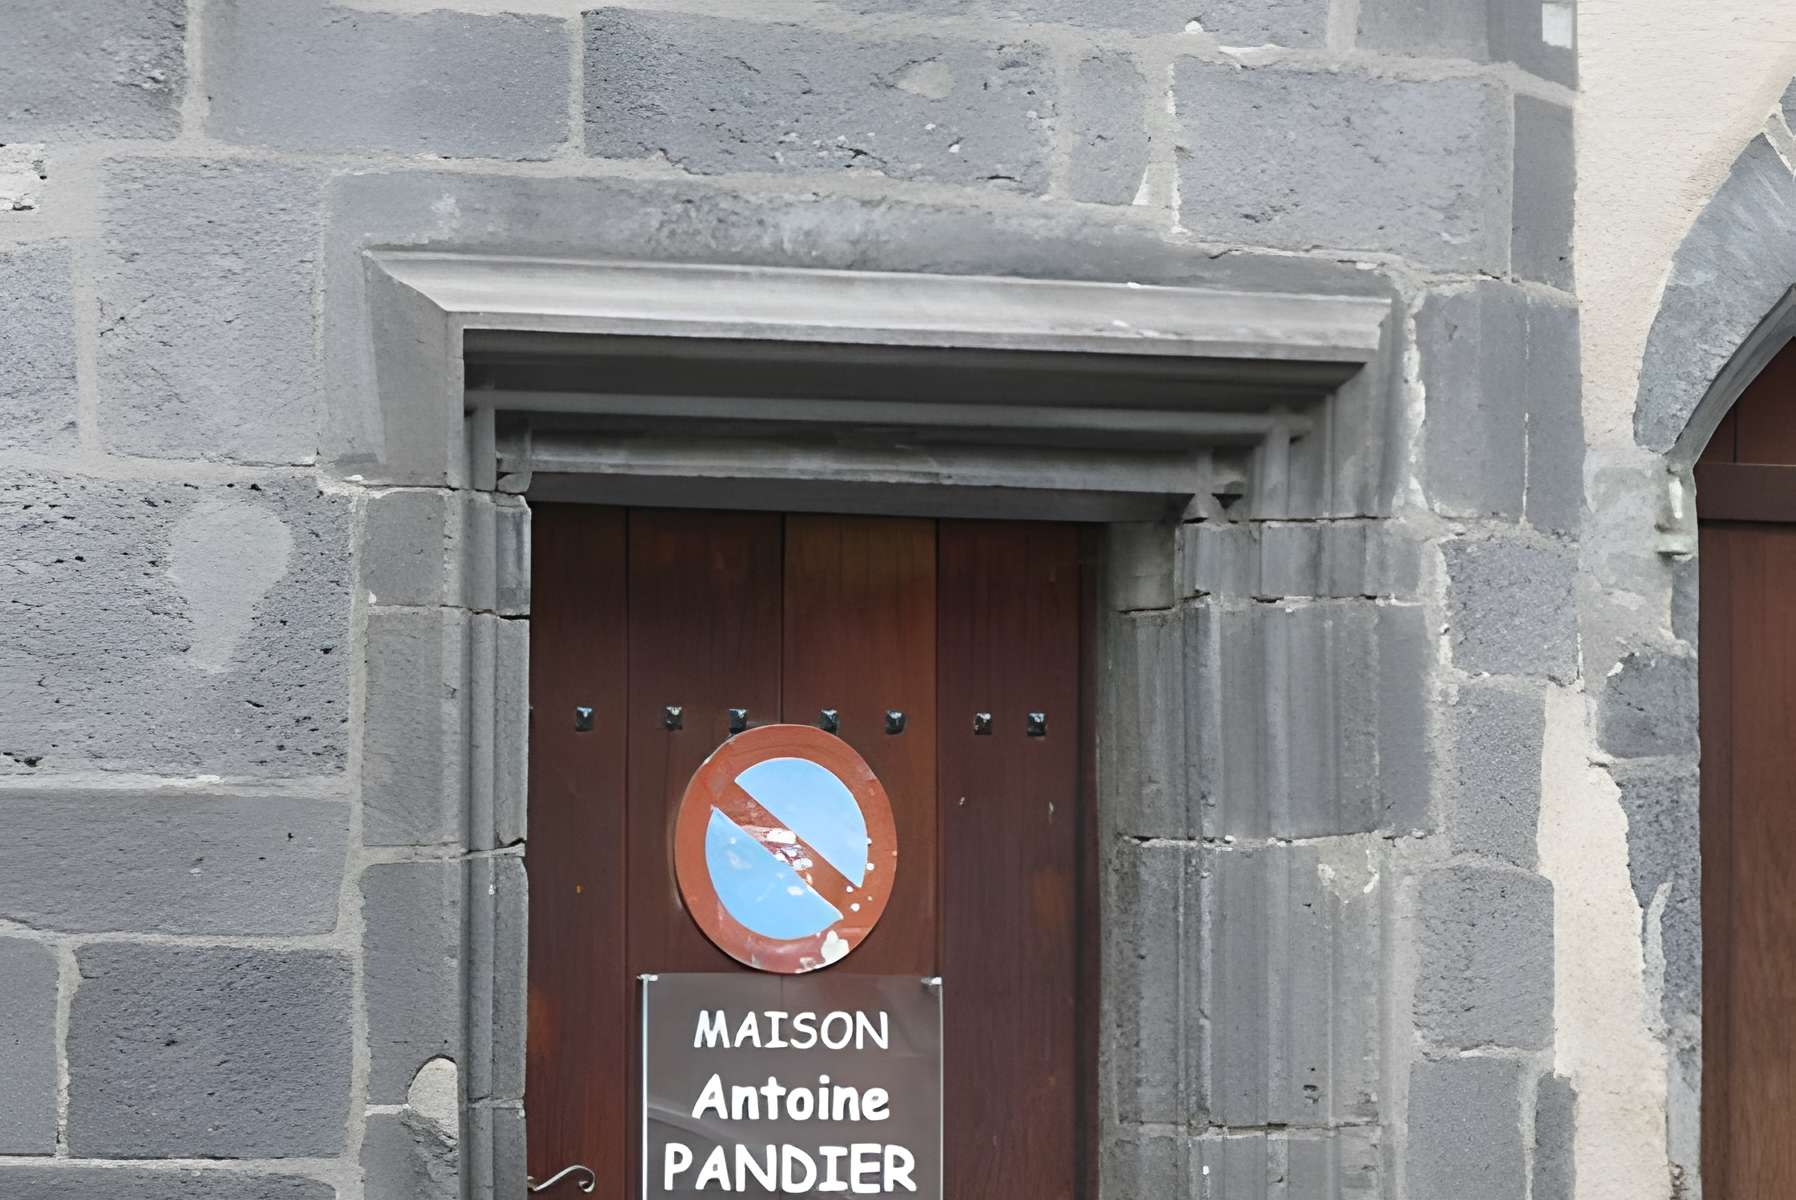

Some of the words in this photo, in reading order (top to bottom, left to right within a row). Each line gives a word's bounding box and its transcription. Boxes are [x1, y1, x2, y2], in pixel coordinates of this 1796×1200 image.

[693, 1010, 888, 1049] MAISON
[691, 1073, 890, 1121] Antoine
[664, 1142, 917, 1194] PANDIER
